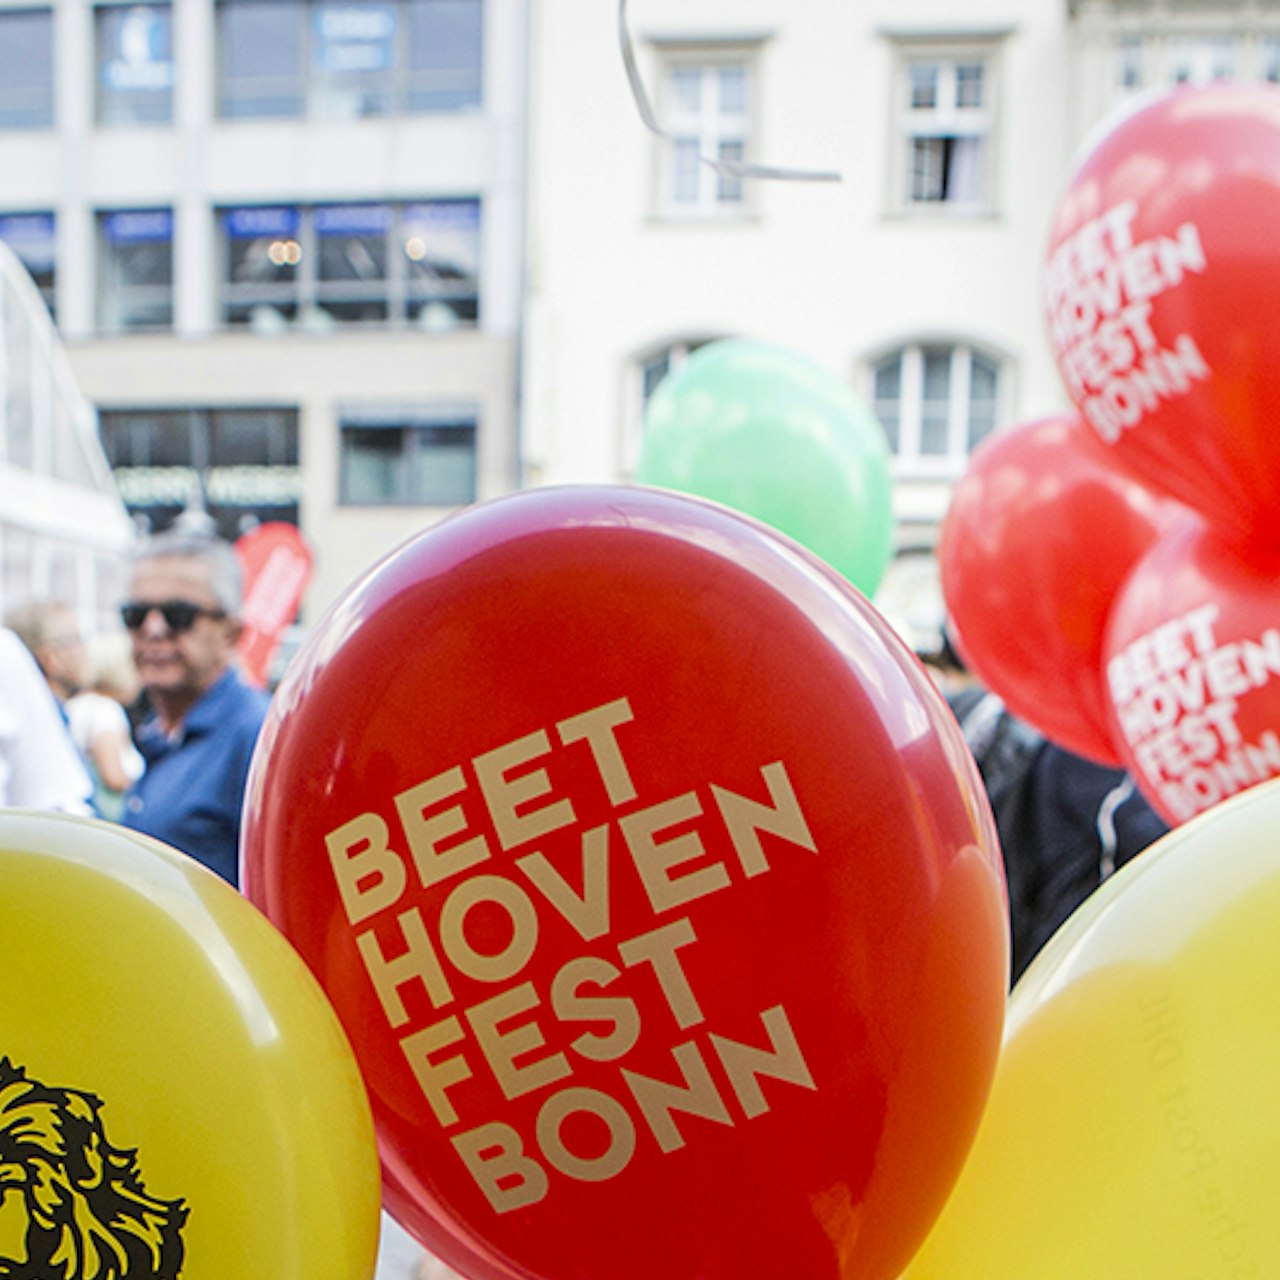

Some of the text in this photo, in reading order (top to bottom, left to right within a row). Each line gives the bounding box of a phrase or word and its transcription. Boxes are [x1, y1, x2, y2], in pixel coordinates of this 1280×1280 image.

[1107, 603, 1220, 705] BEET
[1136, 700, 1241, 794] FEST
[324, 696, 638, 926] BEET
[356, 760, 818, 1029] HOVEN
[399, 917, 705, 1128] FEST
[450, 1004, 818, 1214] BONN
